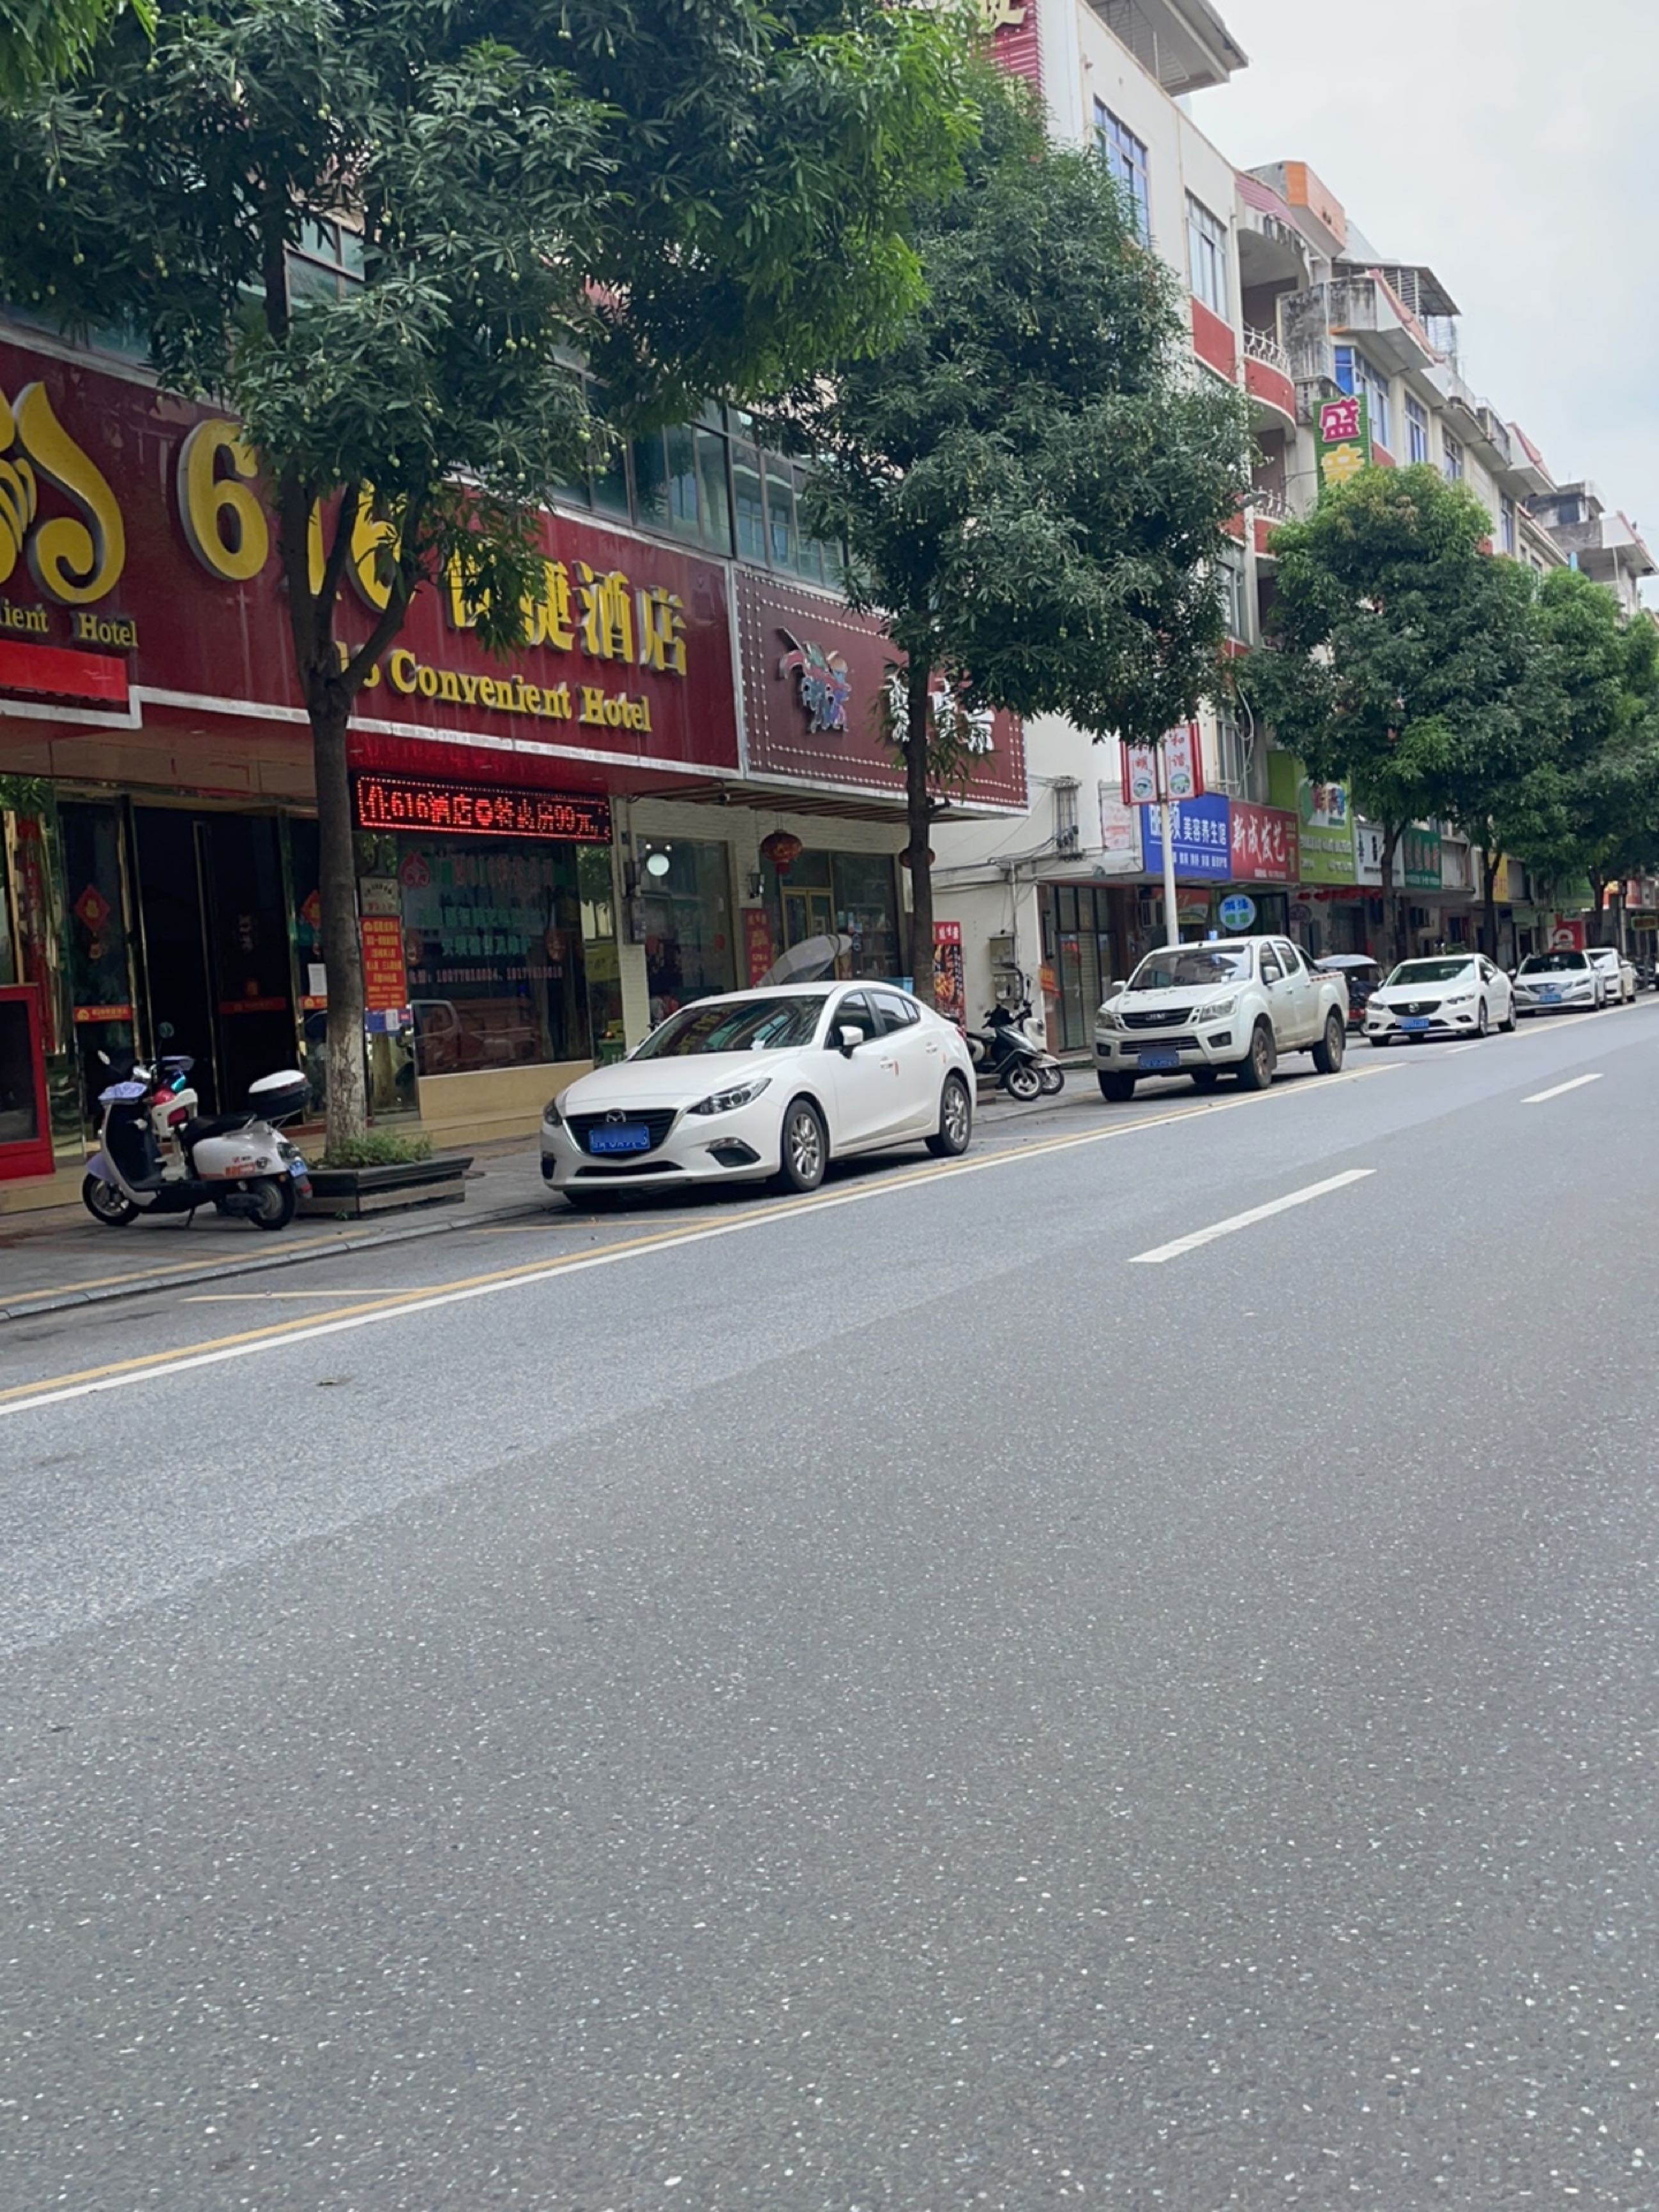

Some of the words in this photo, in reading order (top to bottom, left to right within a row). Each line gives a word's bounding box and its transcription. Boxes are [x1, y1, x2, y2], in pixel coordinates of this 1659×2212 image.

[77, 611, 139, 647] Hotel
[390, 649, 572, 719] Convenient
[577, 686, 652, 732] Hotel
